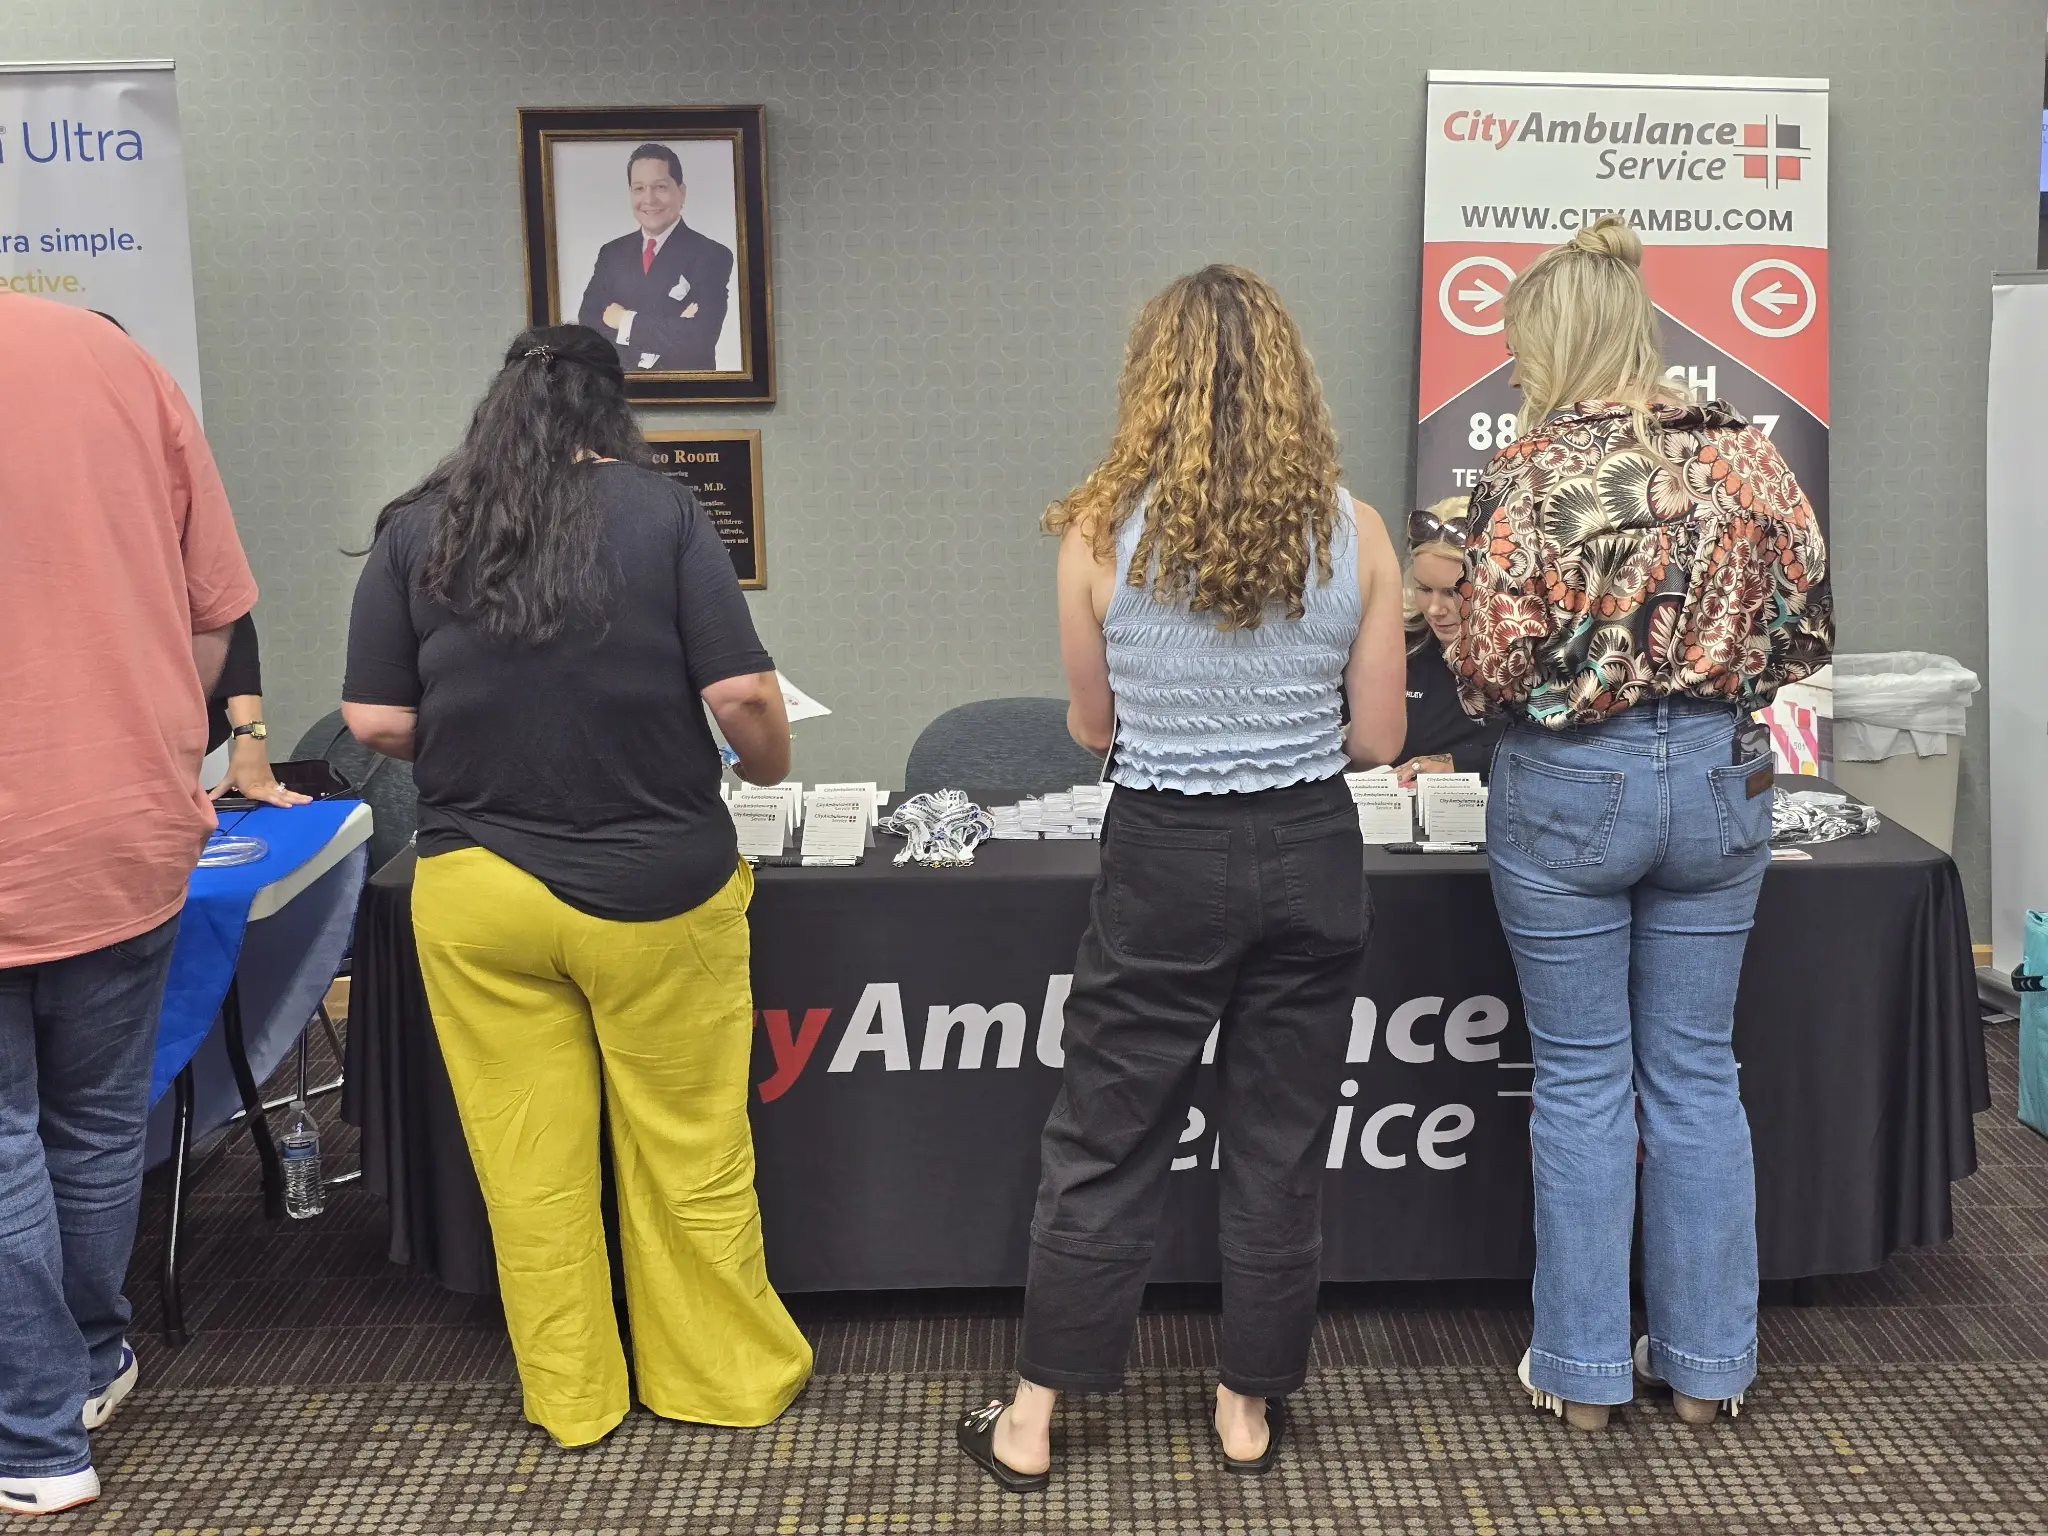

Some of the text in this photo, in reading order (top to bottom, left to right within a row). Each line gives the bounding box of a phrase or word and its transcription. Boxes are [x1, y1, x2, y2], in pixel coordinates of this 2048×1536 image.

[22, 119, 143, 163] Ultra
[1443, 109, 1737, 150] CityAmbulance
[1596, 149, 1726, 181] Service
[0, 228, 142, 257] ra simple.
[674, 449, 720, 464] Room
[704, 483, 726, 491] M.D.
[1452, 468, 1484, 488] TE
